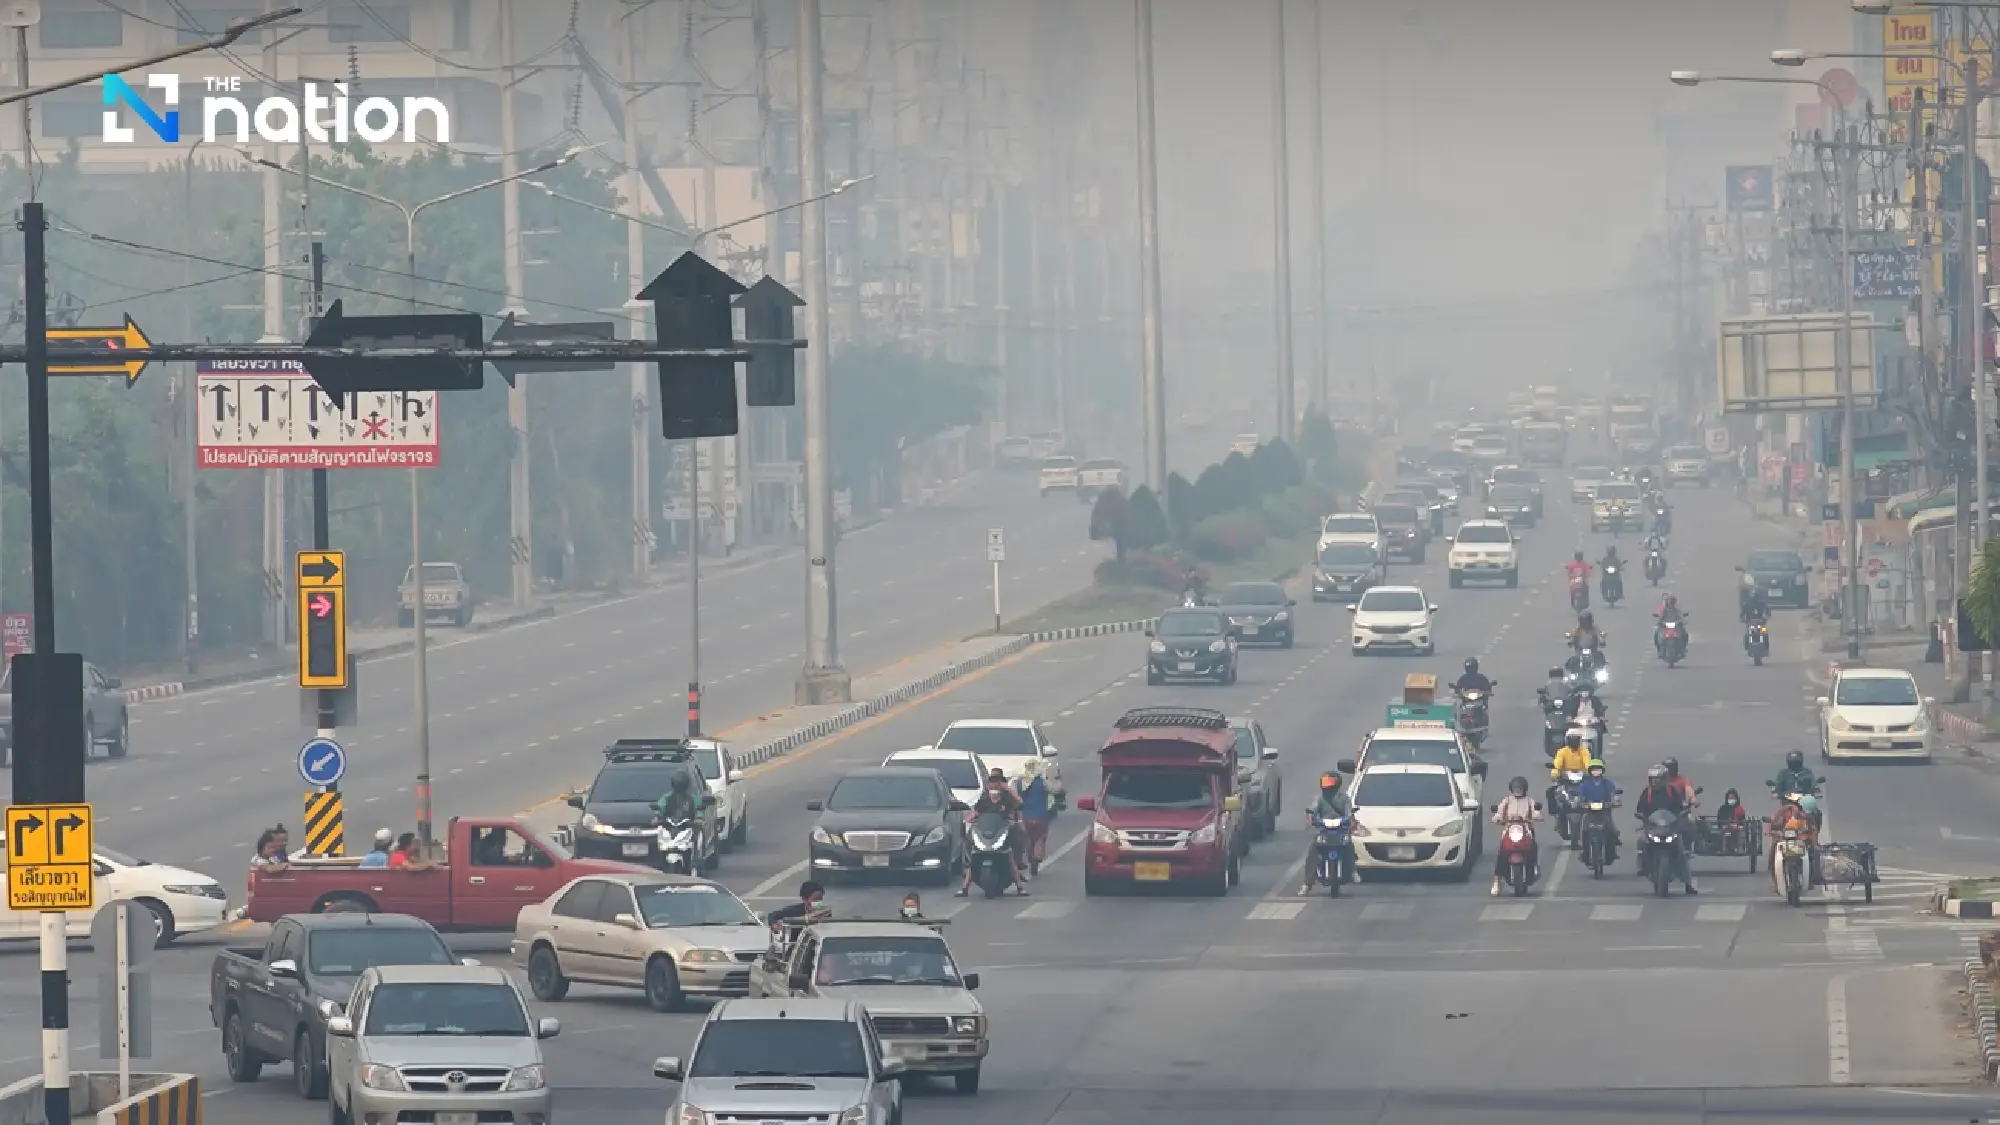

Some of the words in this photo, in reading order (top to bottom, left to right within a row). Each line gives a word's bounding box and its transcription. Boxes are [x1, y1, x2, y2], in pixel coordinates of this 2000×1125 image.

[19, 866, 79, 886] เลี้ยวขวา
[14, 887, 87, 906] รอสัญญาณไฟ
